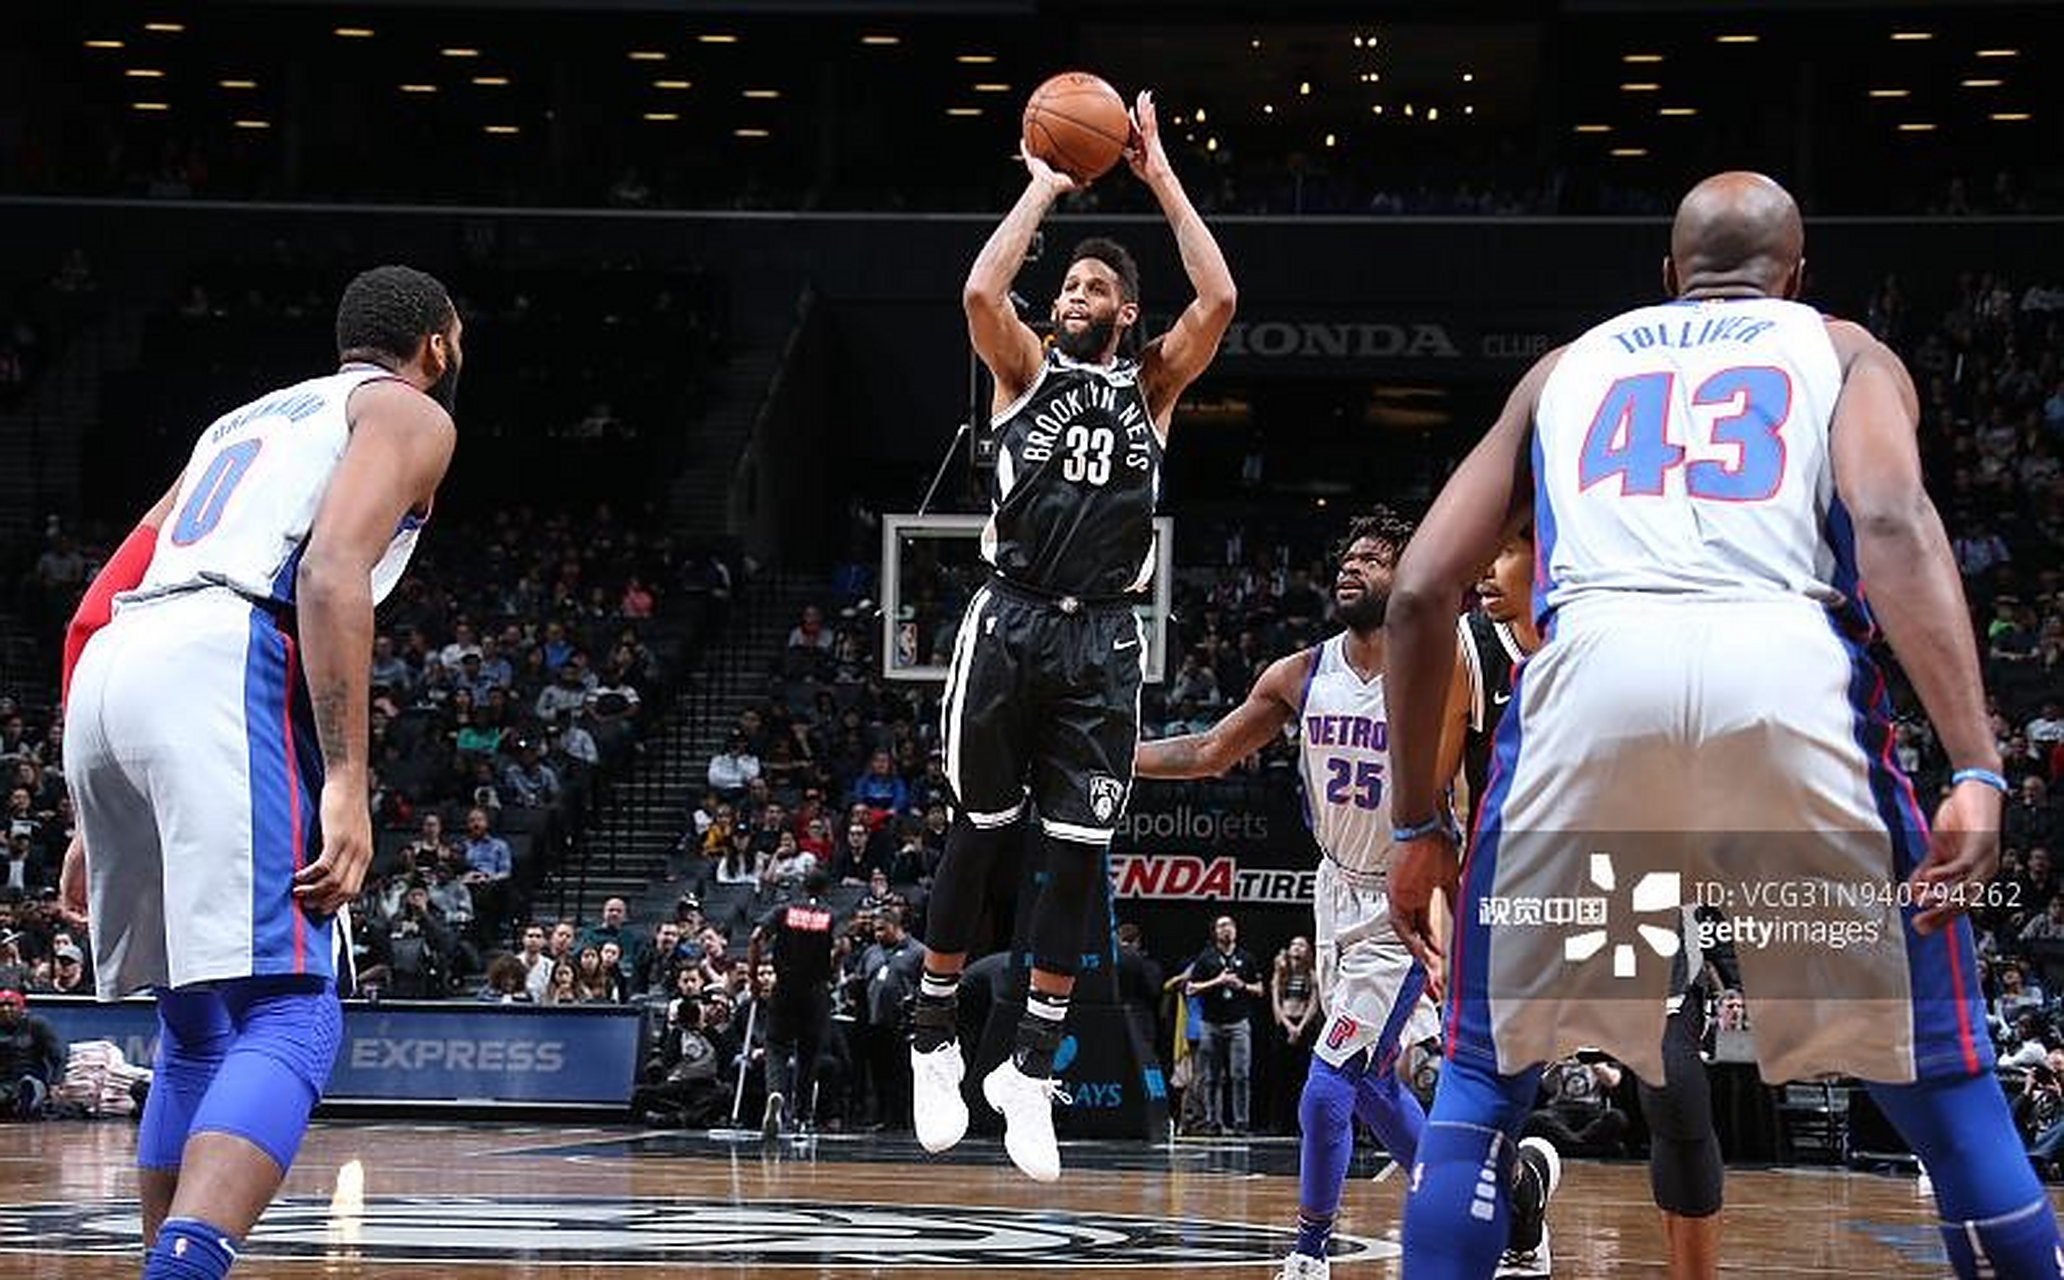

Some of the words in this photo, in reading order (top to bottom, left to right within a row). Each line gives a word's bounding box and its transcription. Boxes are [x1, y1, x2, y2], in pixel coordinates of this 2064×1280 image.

[1612, 316, 1775, 353] TOLLIVER
[1063, 425, 1115, 486] 33
[1118, 402, 1151, 470] NETS
[1578, 365, 1792, 502] 43
[171, 438, 262, 546] 0
[1326, 757, 1384, 811] 25
[350, 1039, 565, 1072] EXPRESS
